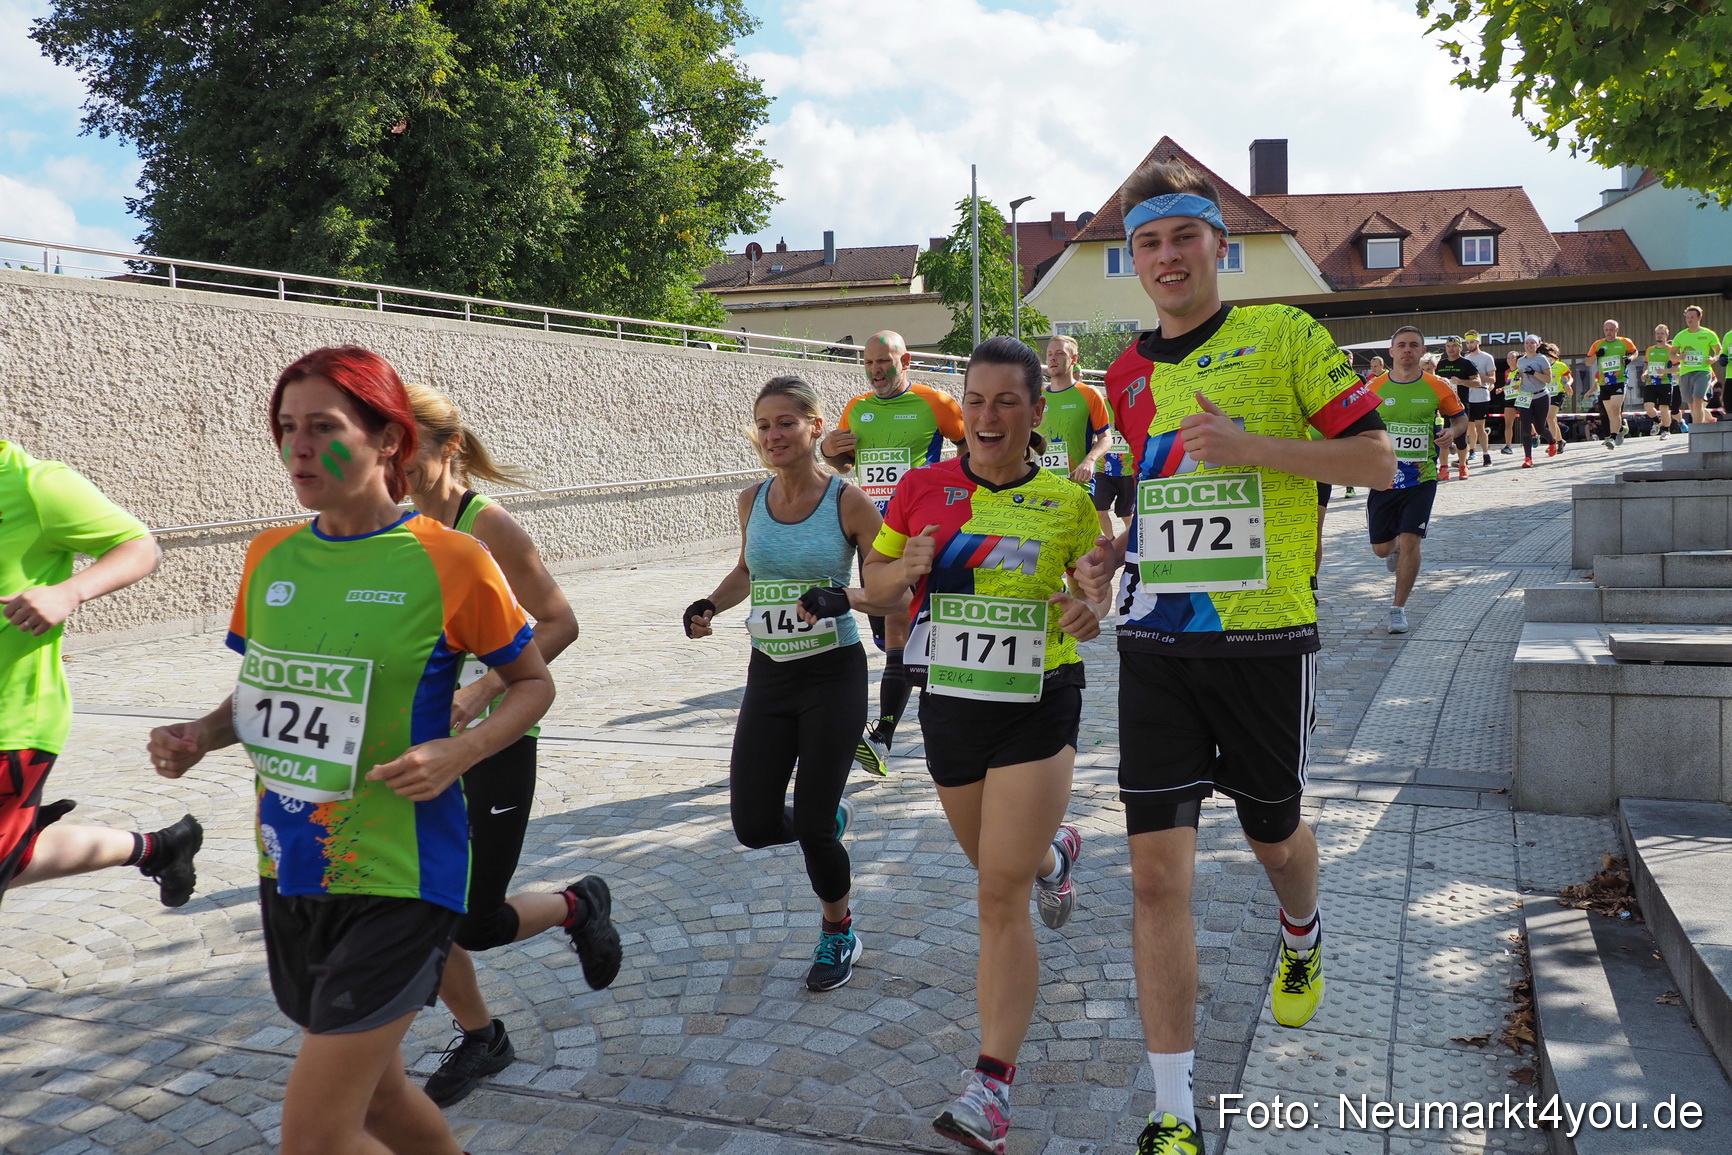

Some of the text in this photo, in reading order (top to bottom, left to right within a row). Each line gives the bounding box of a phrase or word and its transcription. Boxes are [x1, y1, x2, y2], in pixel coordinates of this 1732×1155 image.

[1390, 424, 1427, 435] BOCK
[1047, 444, 1064, 452] CK
[1395, 437, 1421, 449] 190
[860, 450, 905, 463] BOCK
[1039, 455, 1060, 467] 192
[867, 467, 897, 483] 526
[865, 487, 896, 495] MARKU
[1144, 479, 1251, 510] BOCK
[1159, 516, 1233, 553] 172
[1152, 564, 1173, 578] KAI
[345, 590, 407, 604] BOCK
[940, 598, 1037, 627] BOCK
[760, 638, 820, 652] YVONNE
[955, 632, 1017, 666] 171
[242, 648, 354, 698] BOCK
[938, 670, 974, 684] ERIKA
[255, 698, 330, 750] 124
[349, 712, 360, 724] E6
